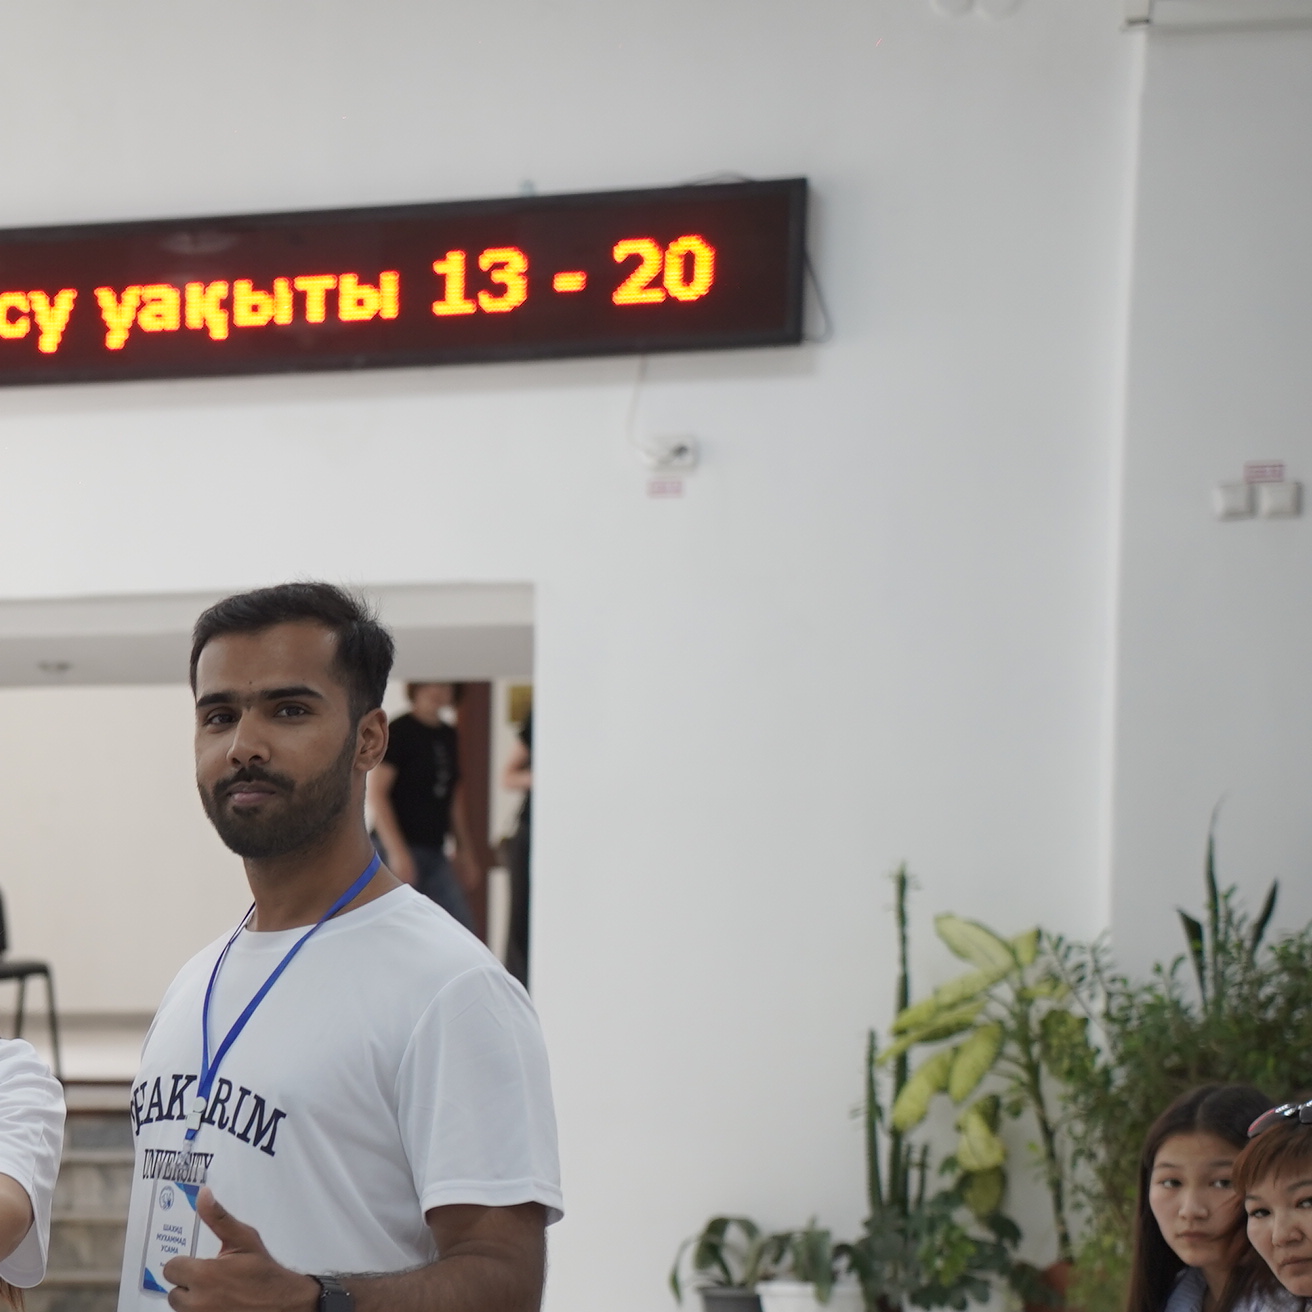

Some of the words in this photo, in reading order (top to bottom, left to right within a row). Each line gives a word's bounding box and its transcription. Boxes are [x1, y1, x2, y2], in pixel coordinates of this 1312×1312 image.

[93, 269, 401, 350] уақыты
[432, 246, 528, 317] 13
[553, 270, 587, 293] -
[612, 233, 716, 306] 20
[130, 1073, 287, 1157] HAKRIM
